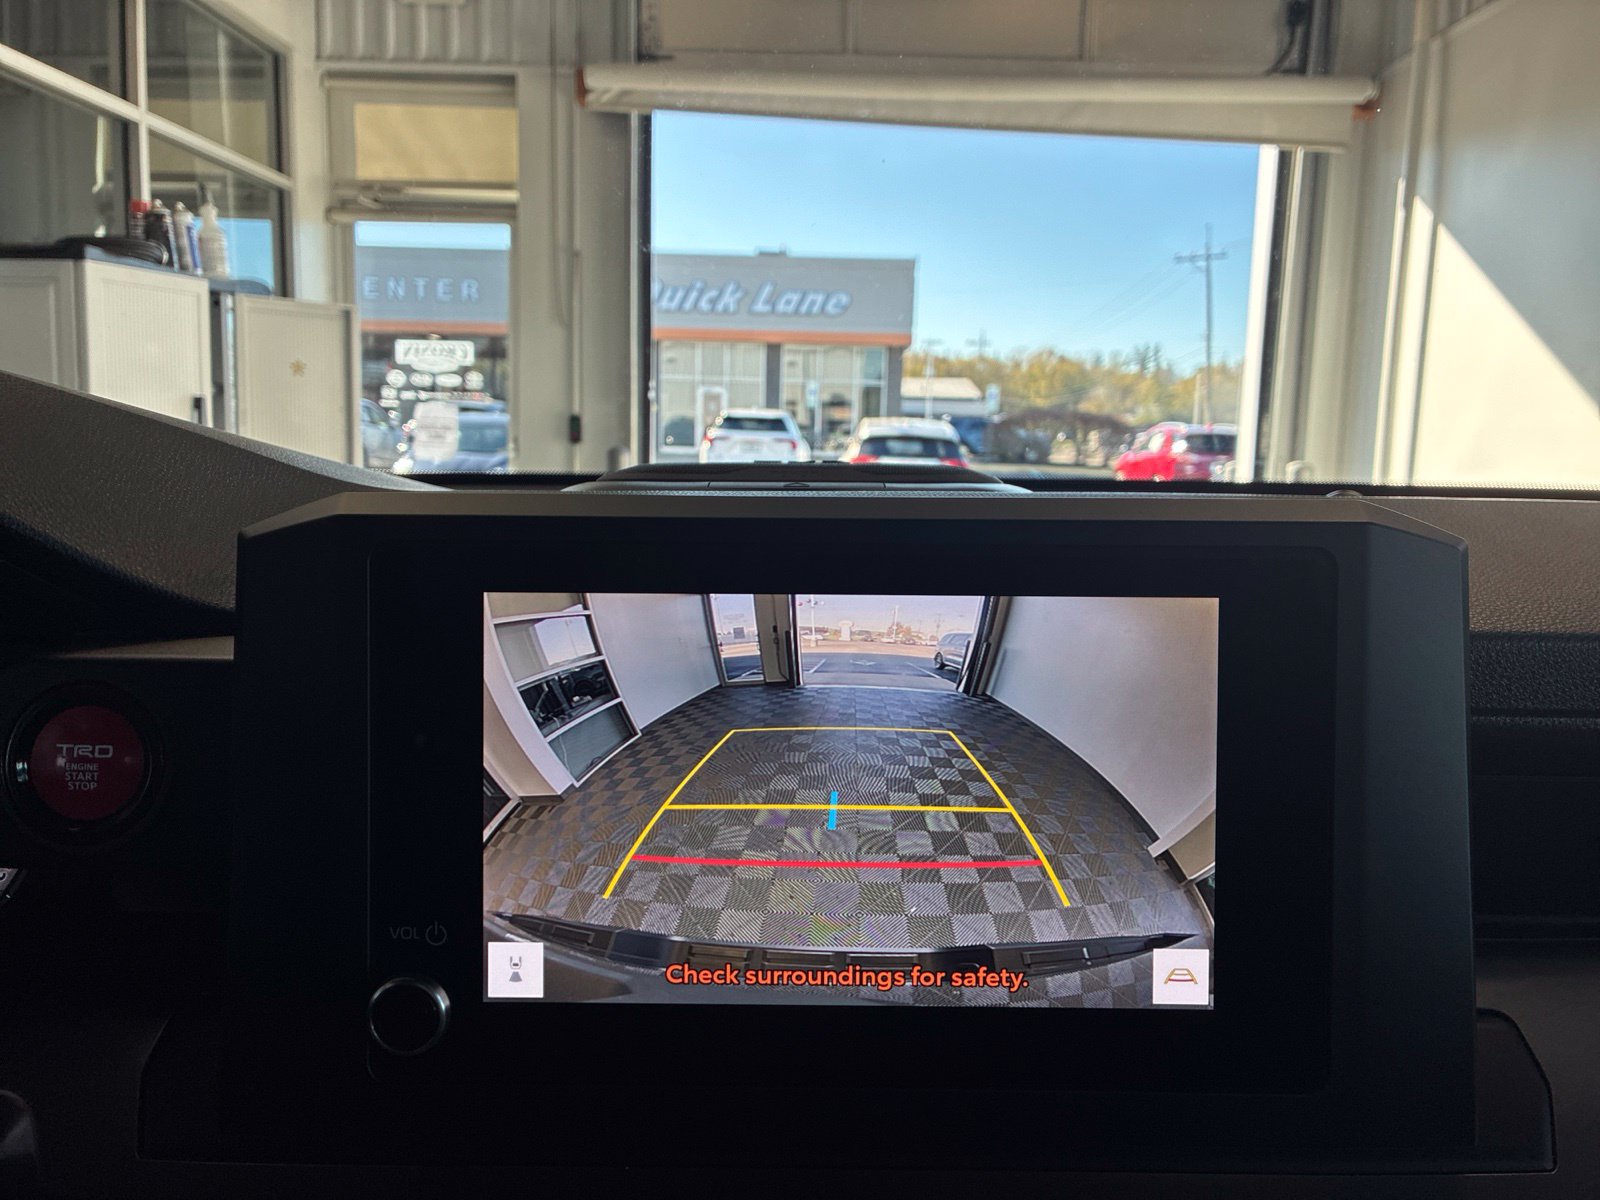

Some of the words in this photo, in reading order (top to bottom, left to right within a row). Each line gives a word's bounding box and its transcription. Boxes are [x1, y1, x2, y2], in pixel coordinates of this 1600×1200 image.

[362, 276, 480, 300] ENTER
[750, 281, 850, 315] Lane
[56, 743, 113, 758] TRD
[65, 763, 99, 771] ENGINE
[65, 772, 99, 781] START
[68, 782, 97, 791] STOP
[389, 926, 420, 940] VOL
[665, 964, 740, 986] Check
[744, 965, 906, 991] surroundings
[910, 966, 946, 988] for
[950, 967, 1030, 992] safety.
